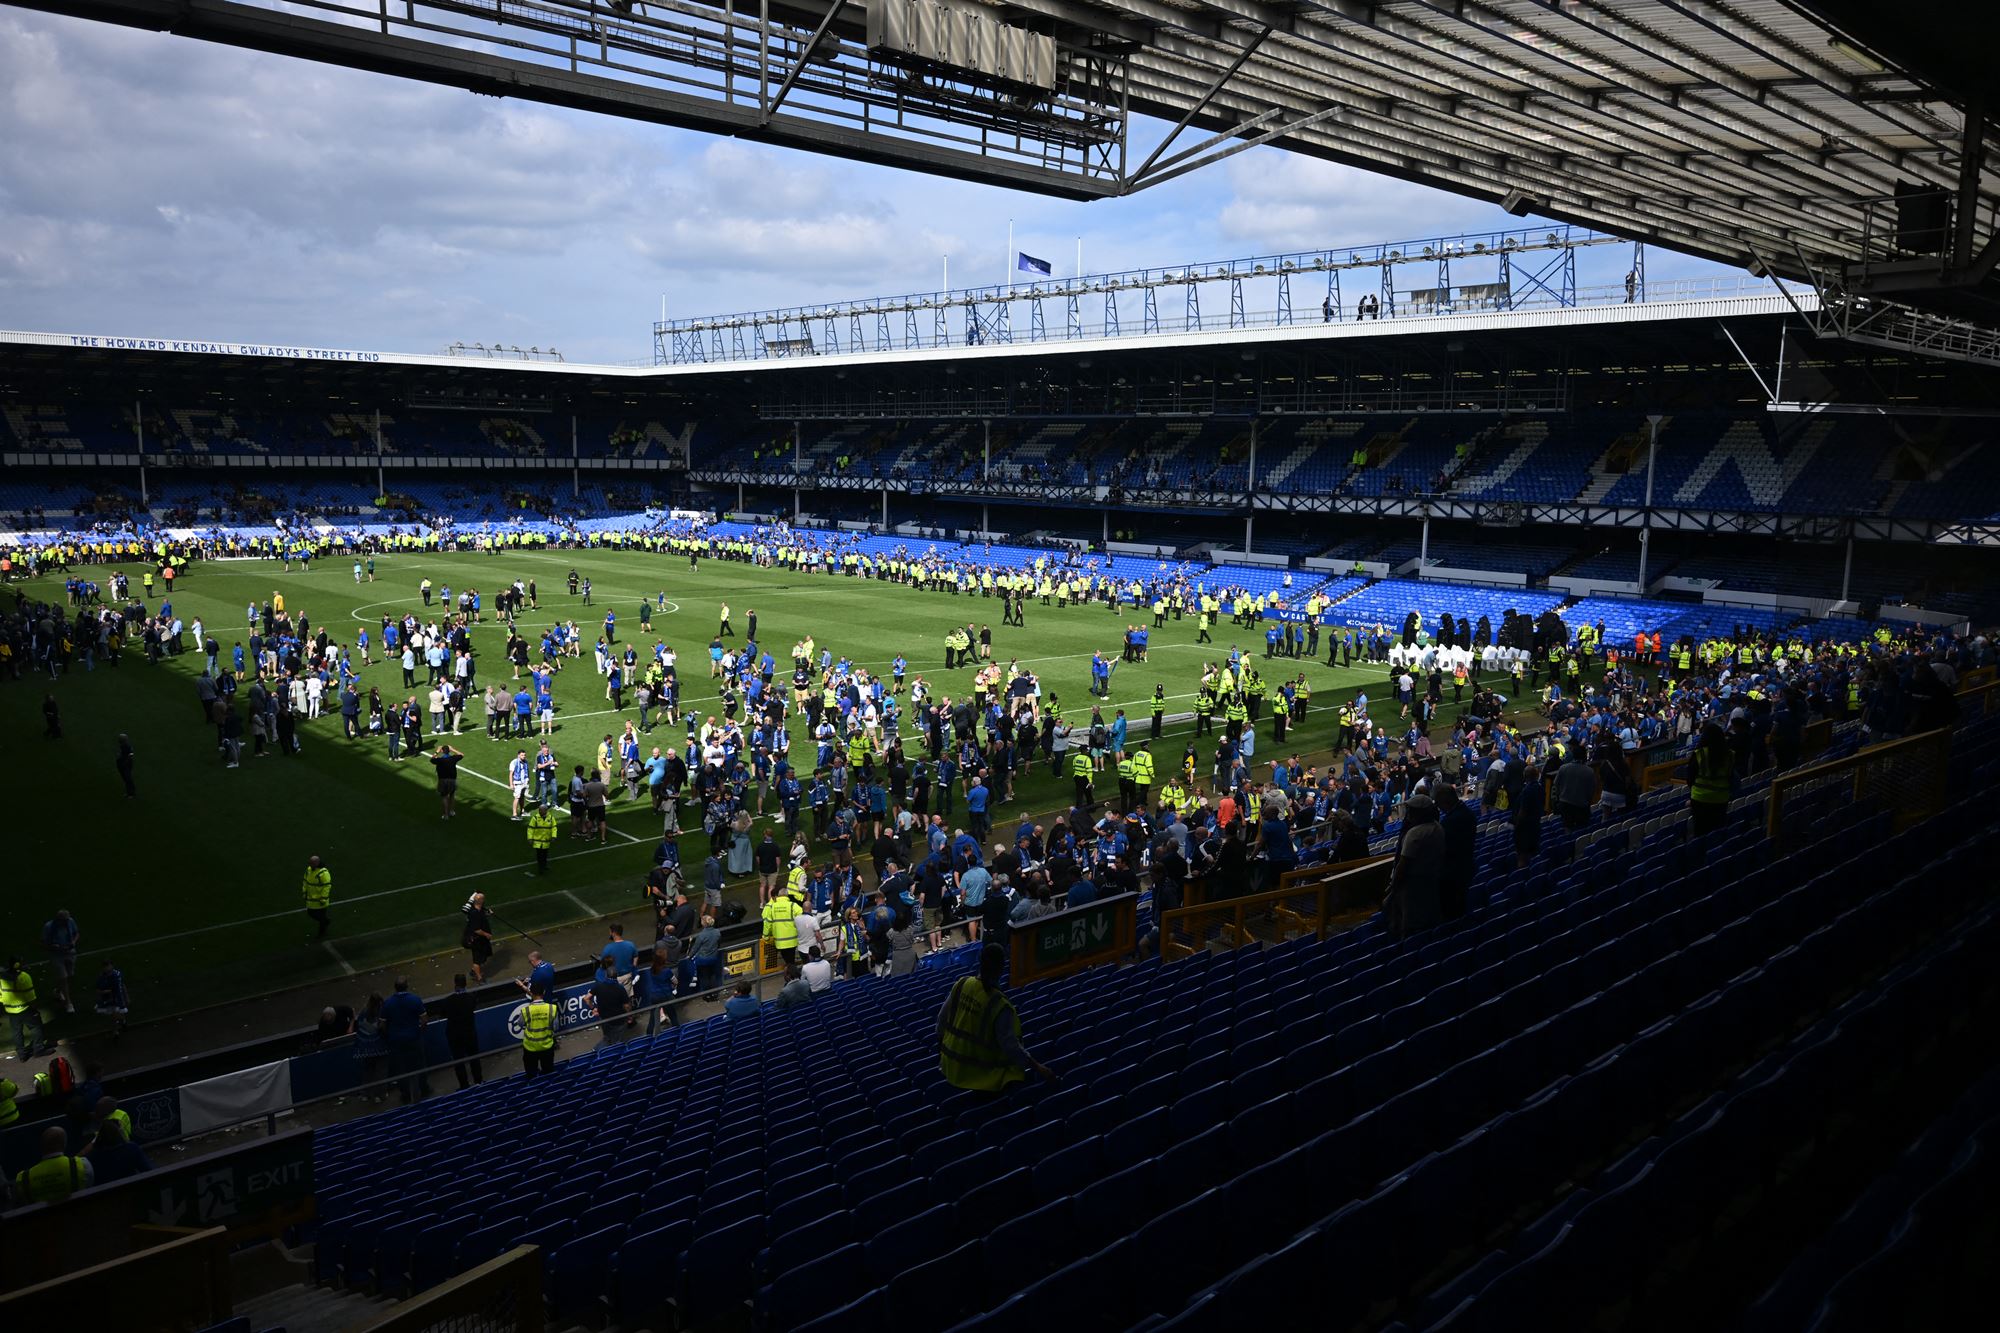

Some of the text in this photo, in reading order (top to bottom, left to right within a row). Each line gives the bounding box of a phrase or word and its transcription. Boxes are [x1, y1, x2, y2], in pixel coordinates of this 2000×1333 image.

[71, 336, 380, 362] THE HOWARD KENDALL GWLADYS STREET END
[1291, 612, 1325, 623] CASRE
[1044, 932, 1065, 950] Exit
[559, 1013, 578, 1027] the
[247, 1160, 305, 1195] EXIT
